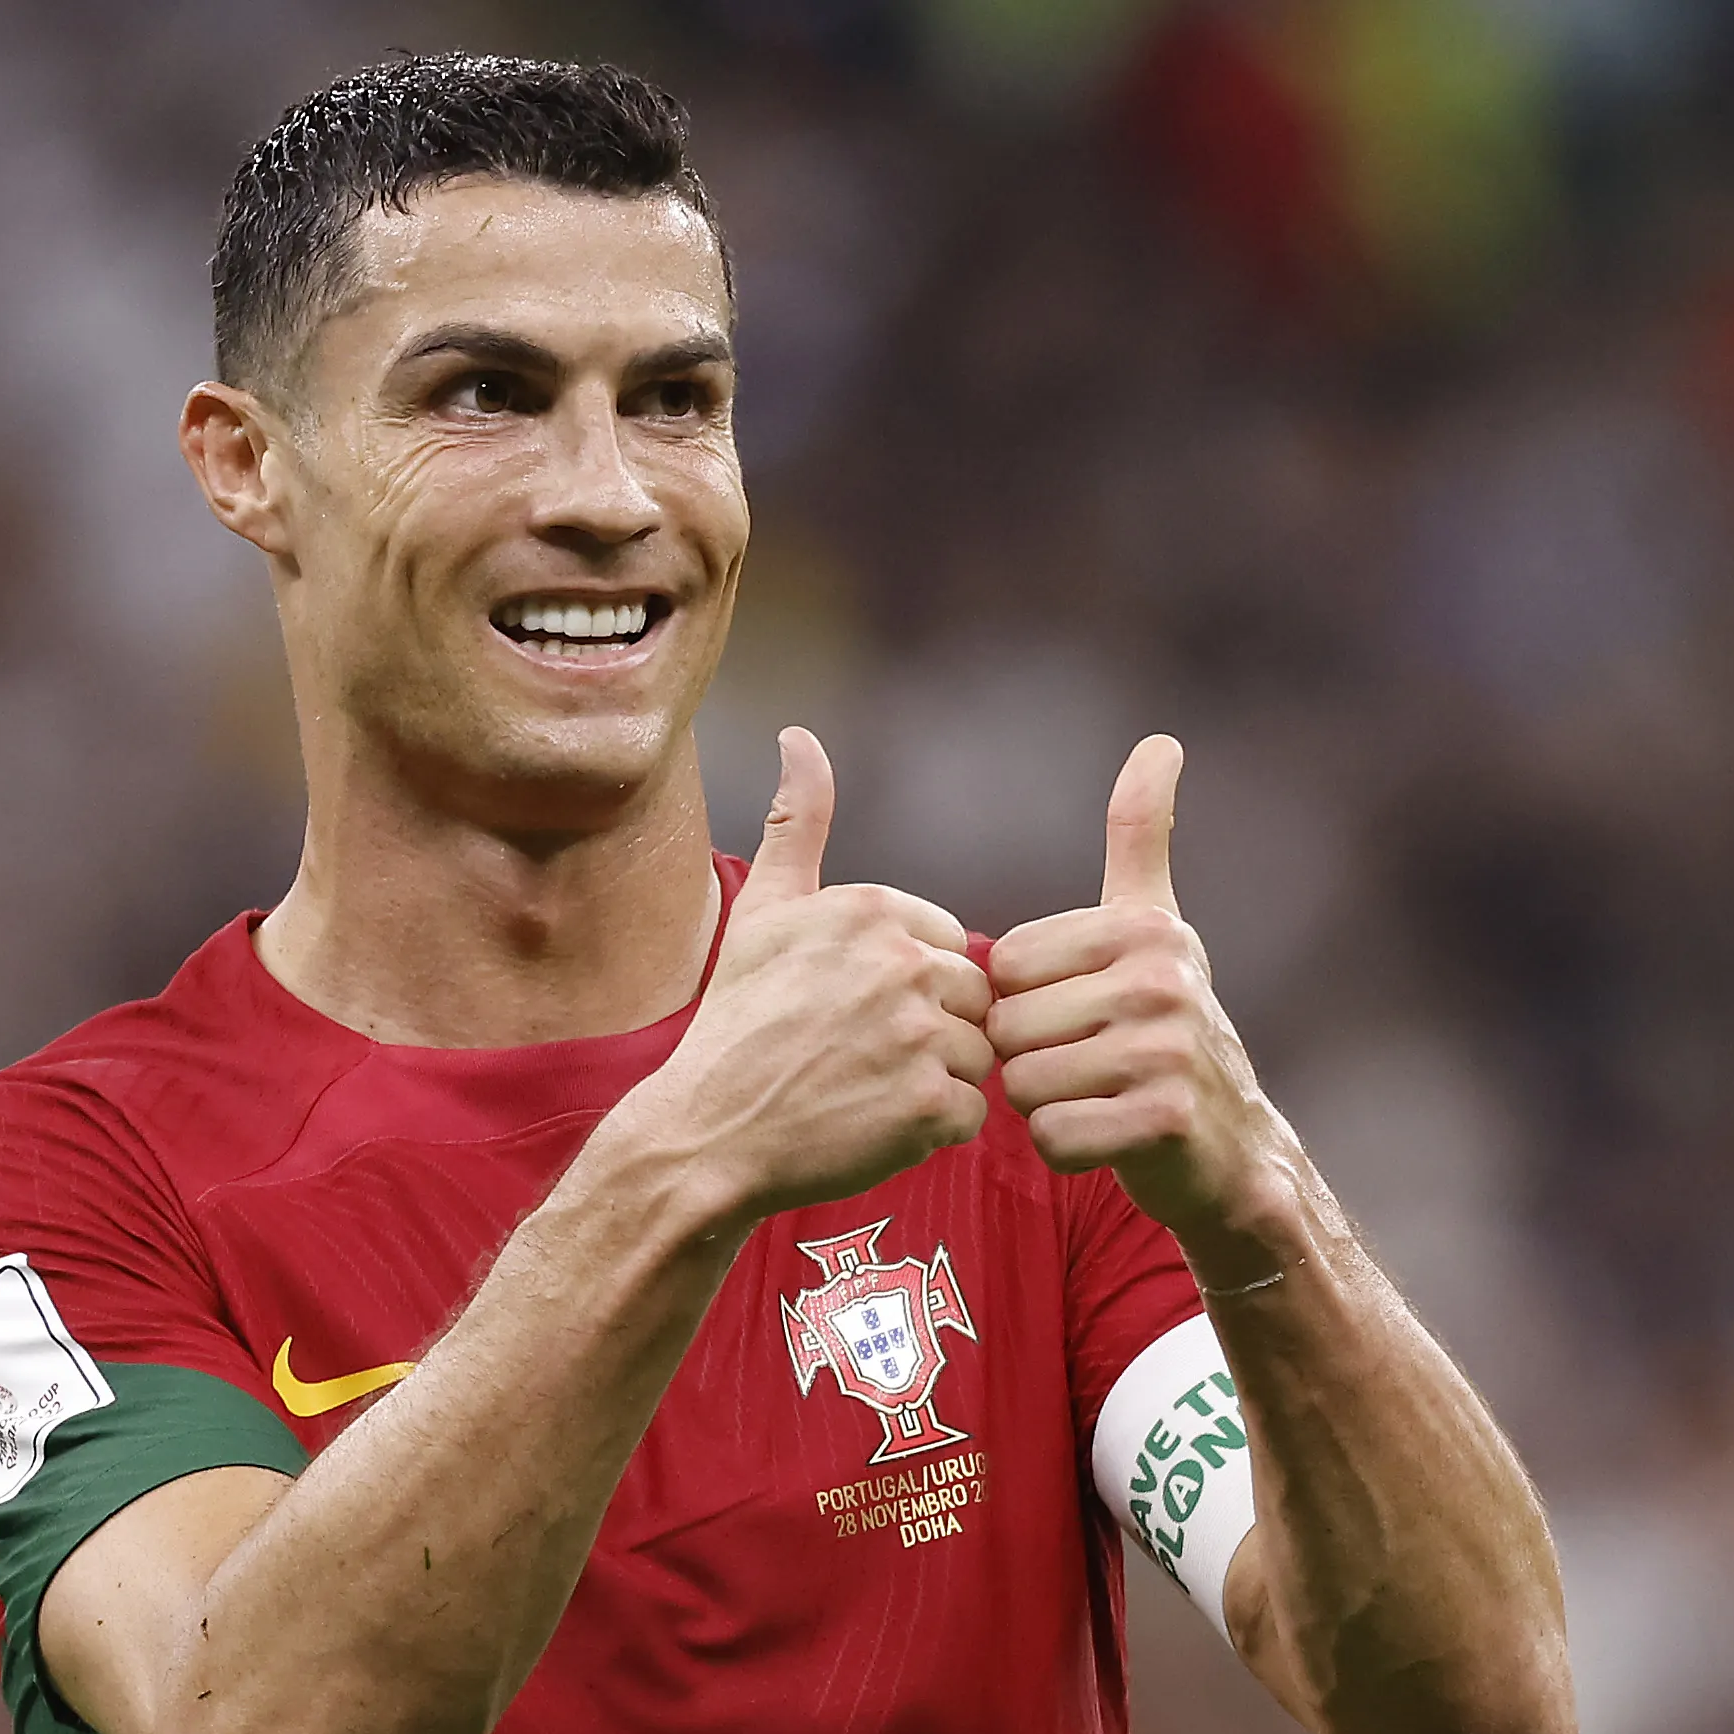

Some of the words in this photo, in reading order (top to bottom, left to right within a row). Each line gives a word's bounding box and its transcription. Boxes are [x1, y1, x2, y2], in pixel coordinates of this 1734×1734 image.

[39, 1383, 59, 1409] CUP
[834, 1512, 857, 1537] 28
[861, 1484, 967, 1531] NOVEMBRO
[900, 1512, 963, 1548] DOHA
